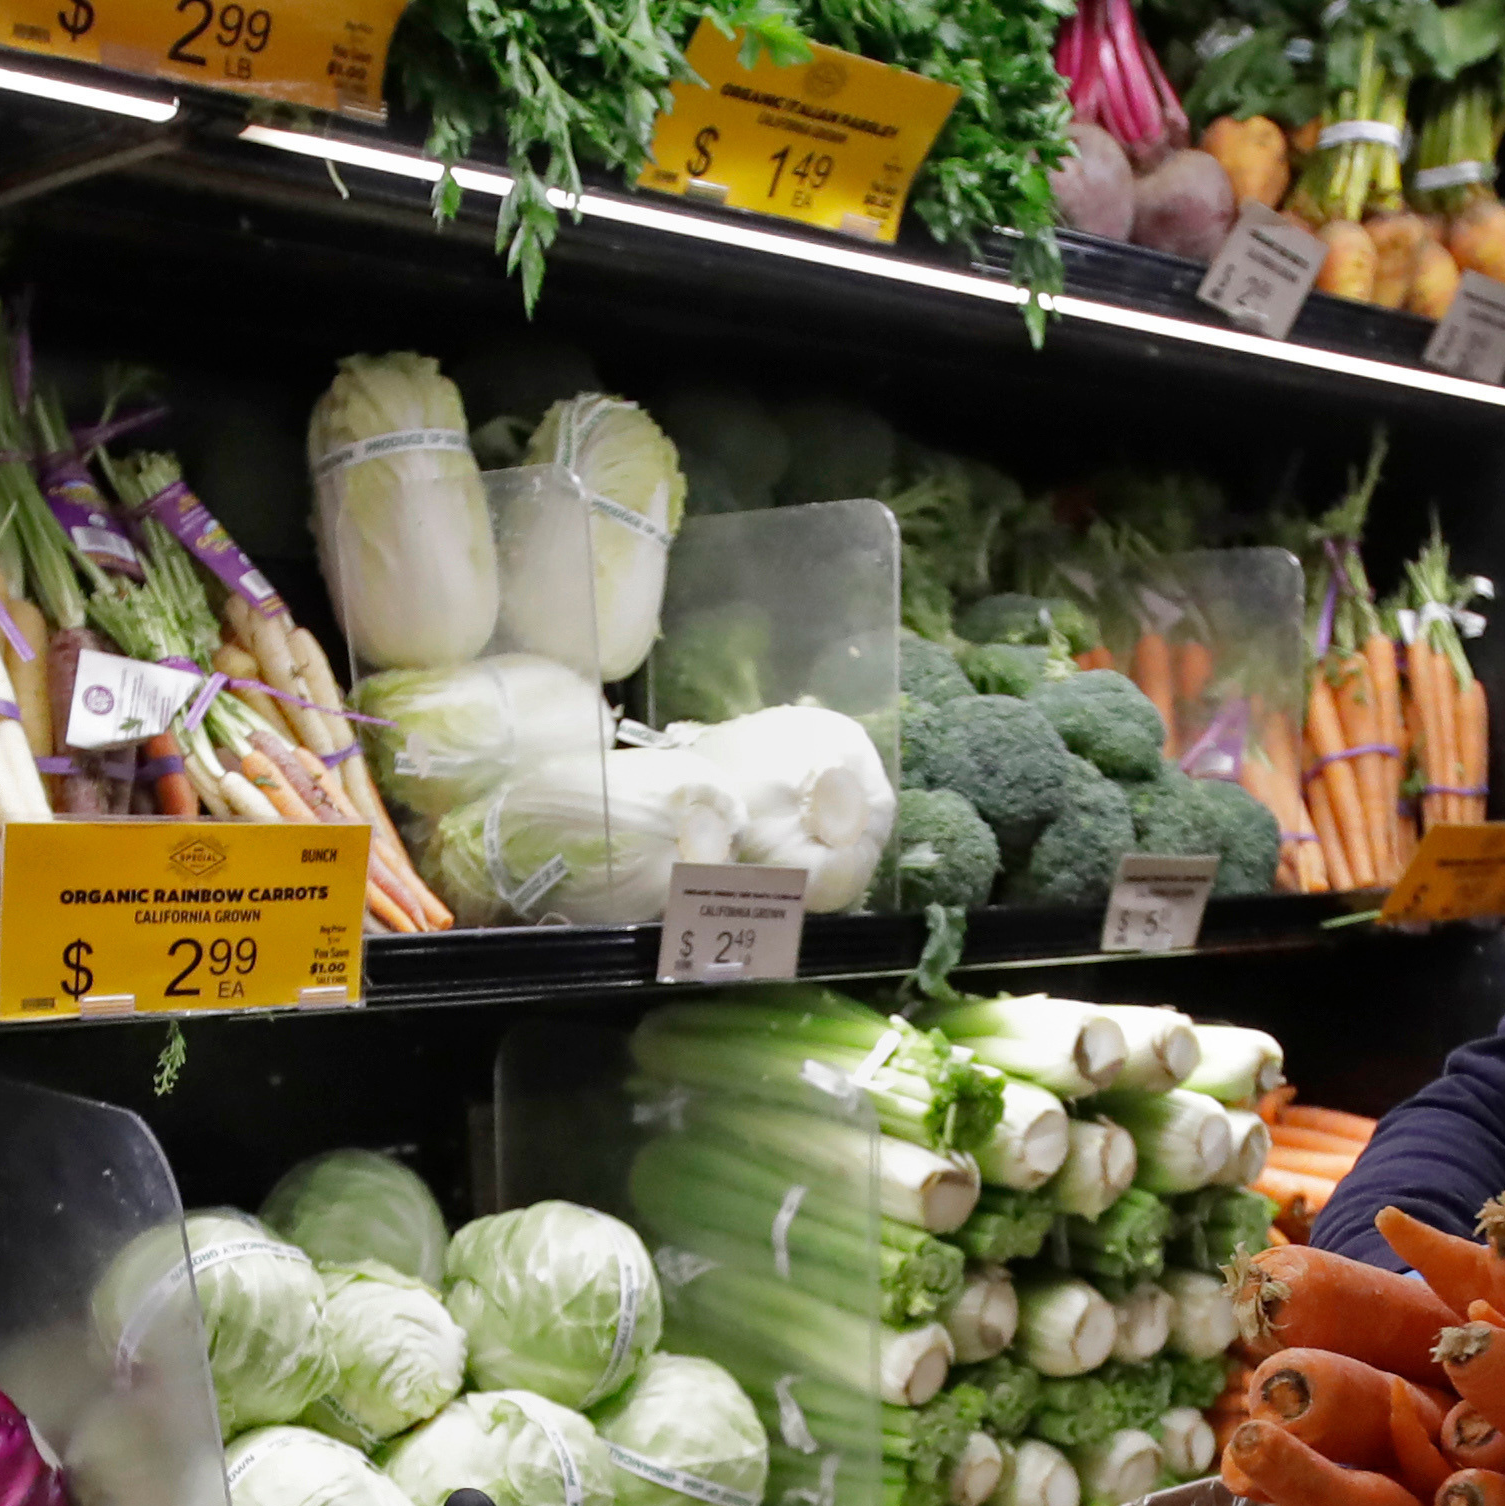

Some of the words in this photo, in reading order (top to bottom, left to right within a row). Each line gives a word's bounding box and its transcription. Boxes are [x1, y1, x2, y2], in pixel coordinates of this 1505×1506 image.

[224, 56, 252, 79] LB
[301, 848, 338, 864] BUNCH
[59, 888, 149, 906] ORGANIC
[153, 887, 244, 904] RAINBOW
[248, 885, 330, 902] CARROTS
[134, 909, 212, 926] CALIFORNIA
[214, 909, 262, 923] GROWN
[60, 937, 94, 1001] $
[310, 962, 346, 975] $1.00
[217, 980, 245, 998] EA
